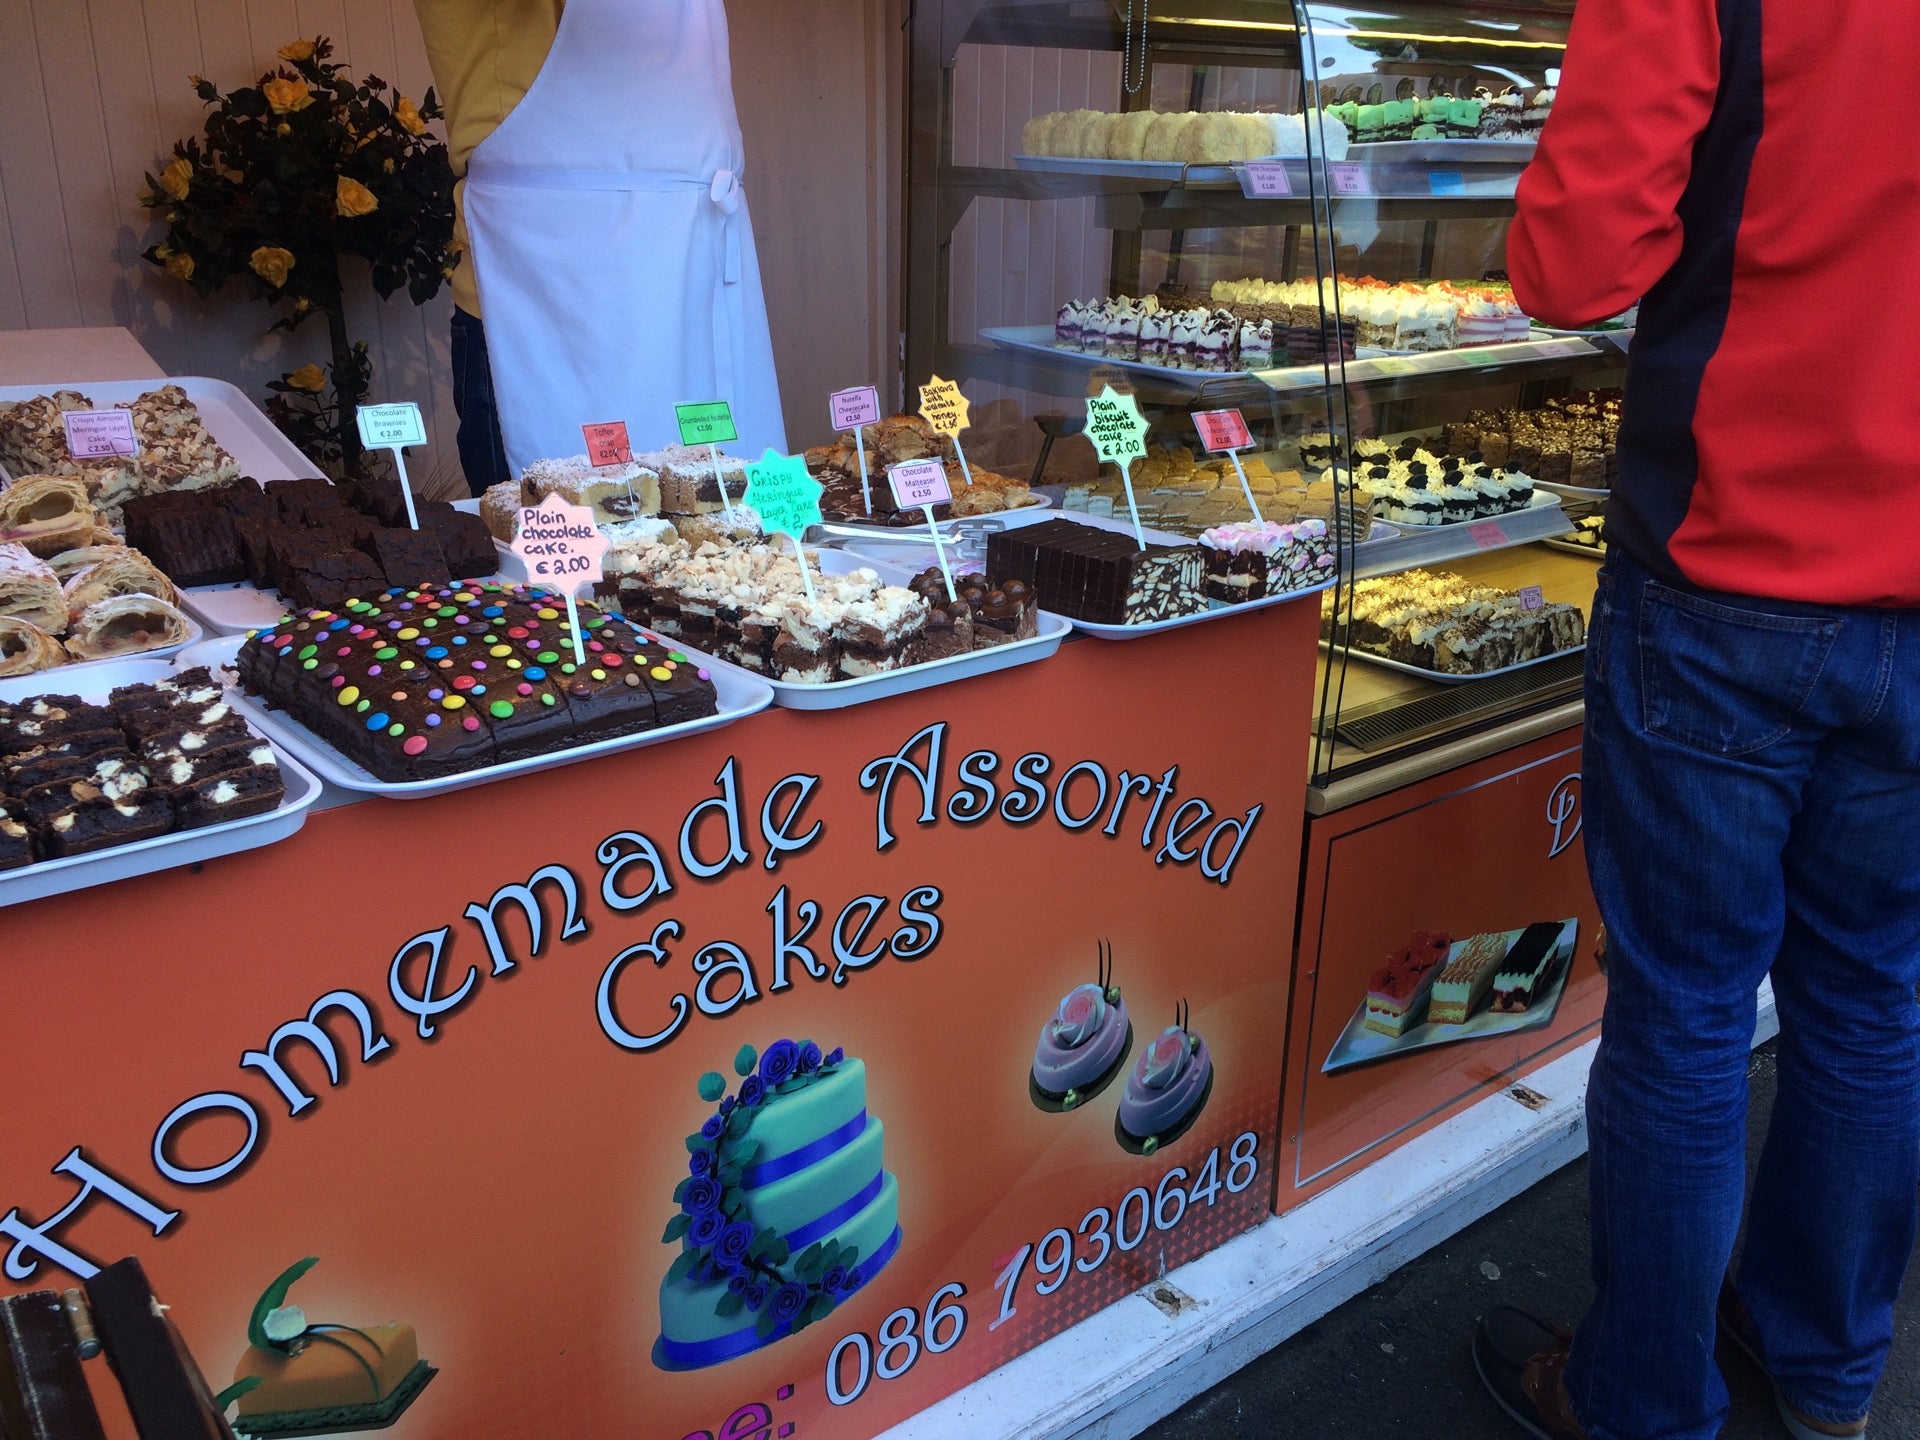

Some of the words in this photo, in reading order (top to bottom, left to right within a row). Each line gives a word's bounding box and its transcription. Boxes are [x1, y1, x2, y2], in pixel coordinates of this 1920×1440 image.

[842, 395, 861, 403] Nutella
[926, 393, 943, 403] with
[839, 403, 869, 413] Cheesecake
[1090, 399, 1116, 413] Plain
[372, 409, 406, 417] Chocolate
[1094, 410, 1129, 424] biscuit
[1091, 421, 1136, 433] chocolate
[1098, 432, 1127, 441] cake.
[902, 467, 932, 477] Chocolate
[905, 478, 935, 487] Malteaser
[524, 509, 565, 525] Plain
[522, 524, 594, 540] chocolate
[524, 542, 574, 555] cake.
[596, 884, 945, 1053] Cakes
[0, 756, 824, 1281] Homemade
[859, 721, 1264, 886] Assorted
[825, 1281, 968, 1406] 086
